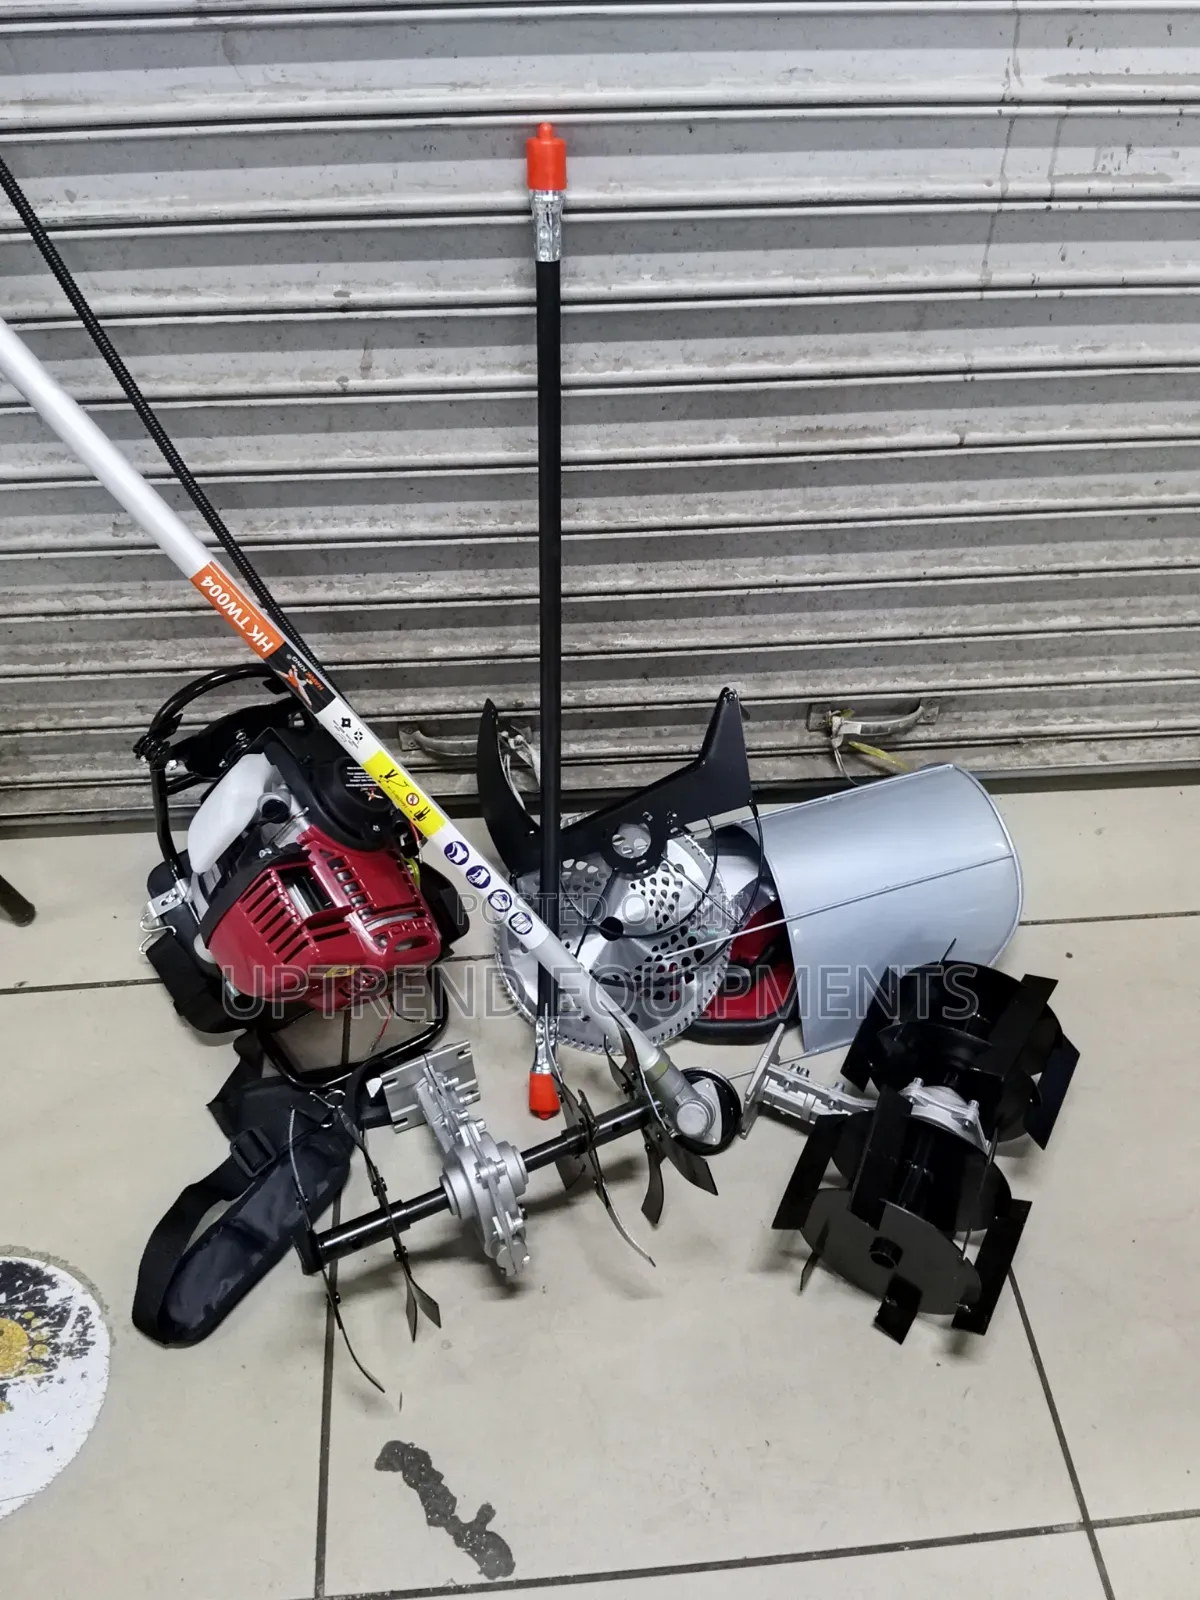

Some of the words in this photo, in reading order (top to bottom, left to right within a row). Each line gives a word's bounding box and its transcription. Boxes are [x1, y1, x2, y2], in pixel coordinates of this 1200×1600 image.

[200, 575, 250, 630] TW004
[246, 624, 274, 653] HK
[304, 671, 325, 691] HAWK
